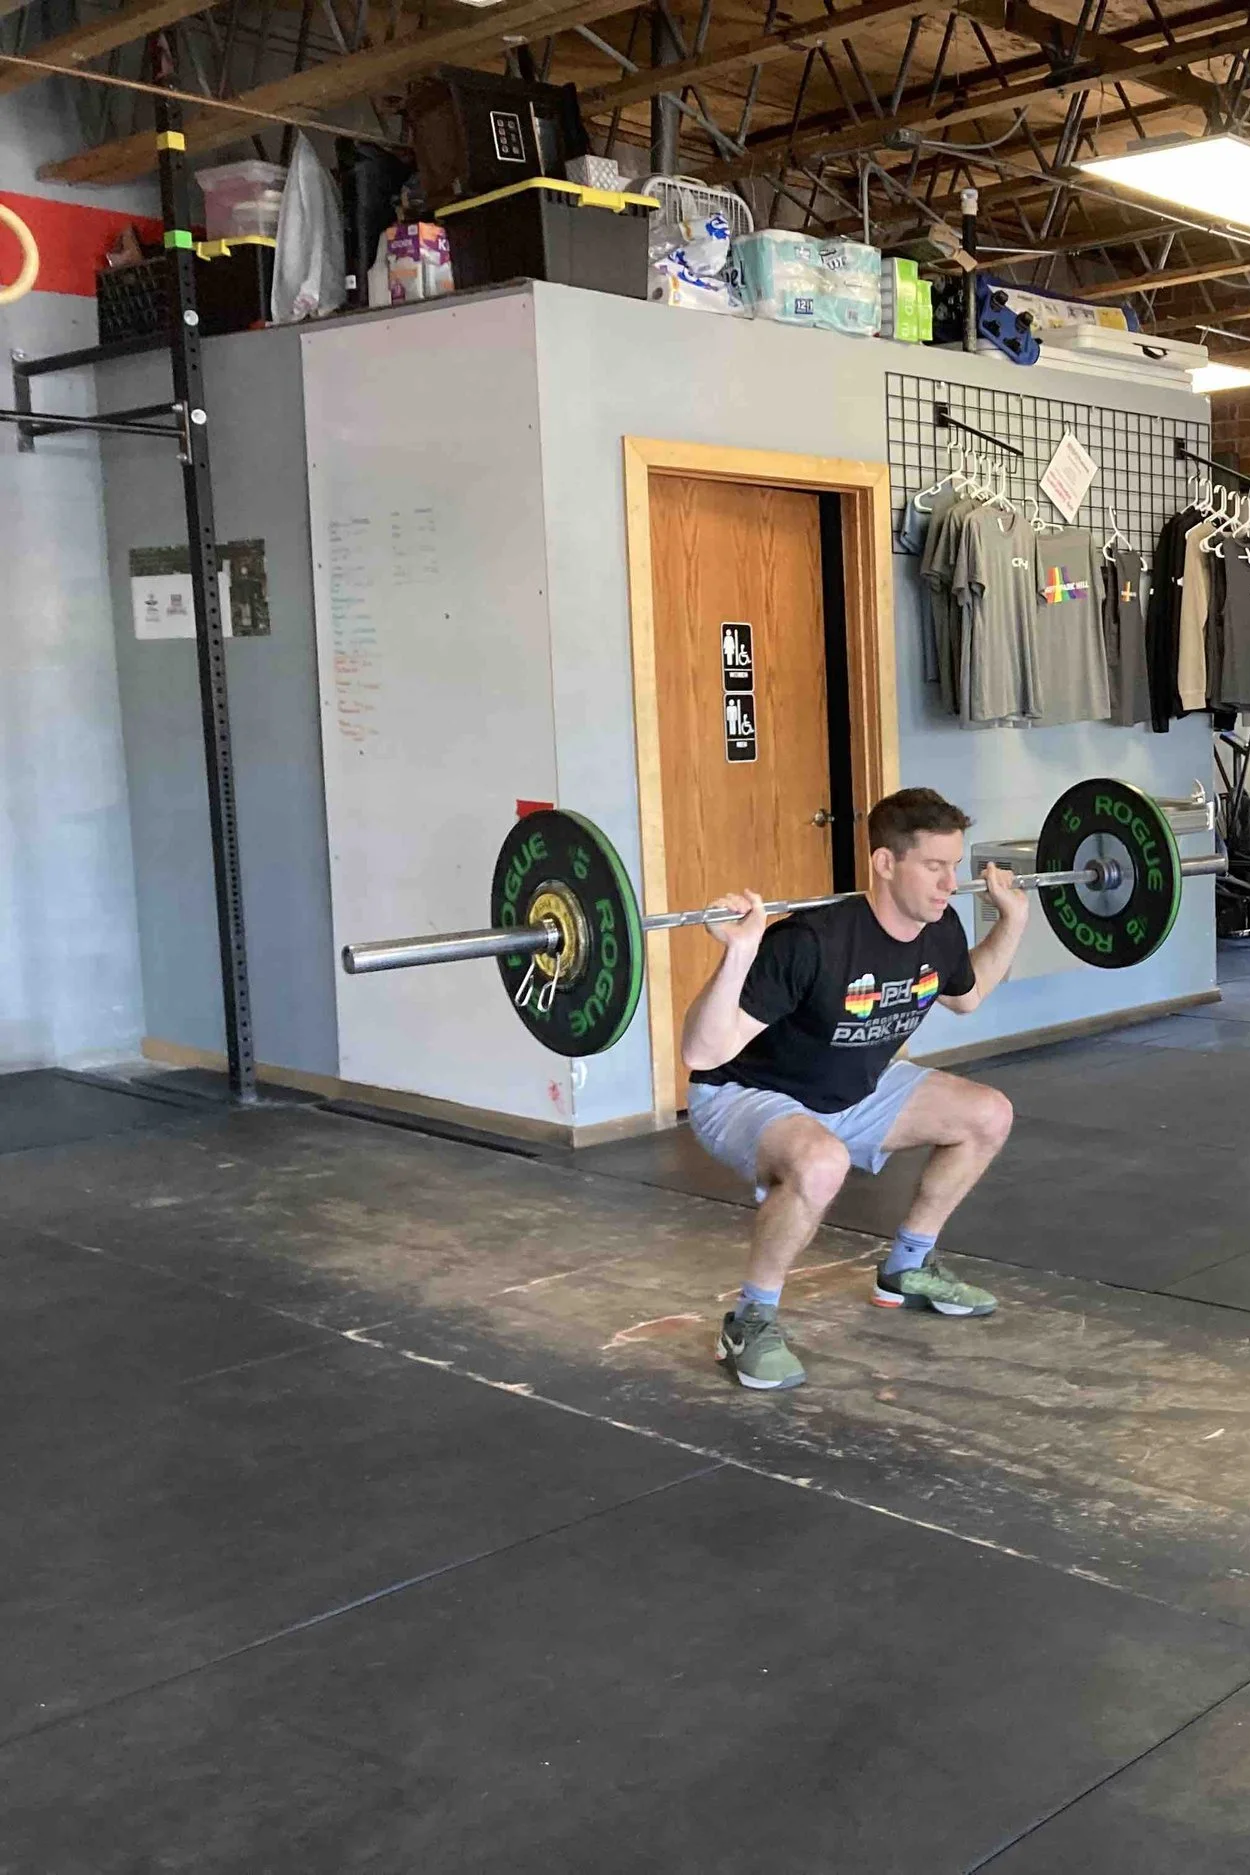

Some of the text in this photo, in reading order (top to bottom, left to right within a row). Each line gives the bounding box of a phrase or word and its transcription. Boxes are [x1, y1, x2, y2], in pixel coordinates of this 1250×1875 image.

[1062, 808, 1082, 833] 10
[1095, 795, 1163, 891] ROGUE
[1126, 917, 1147, 944] 10
[567, 899, 618, 1036] ROGUE
[831, 1022, 893, 1042] PARK
